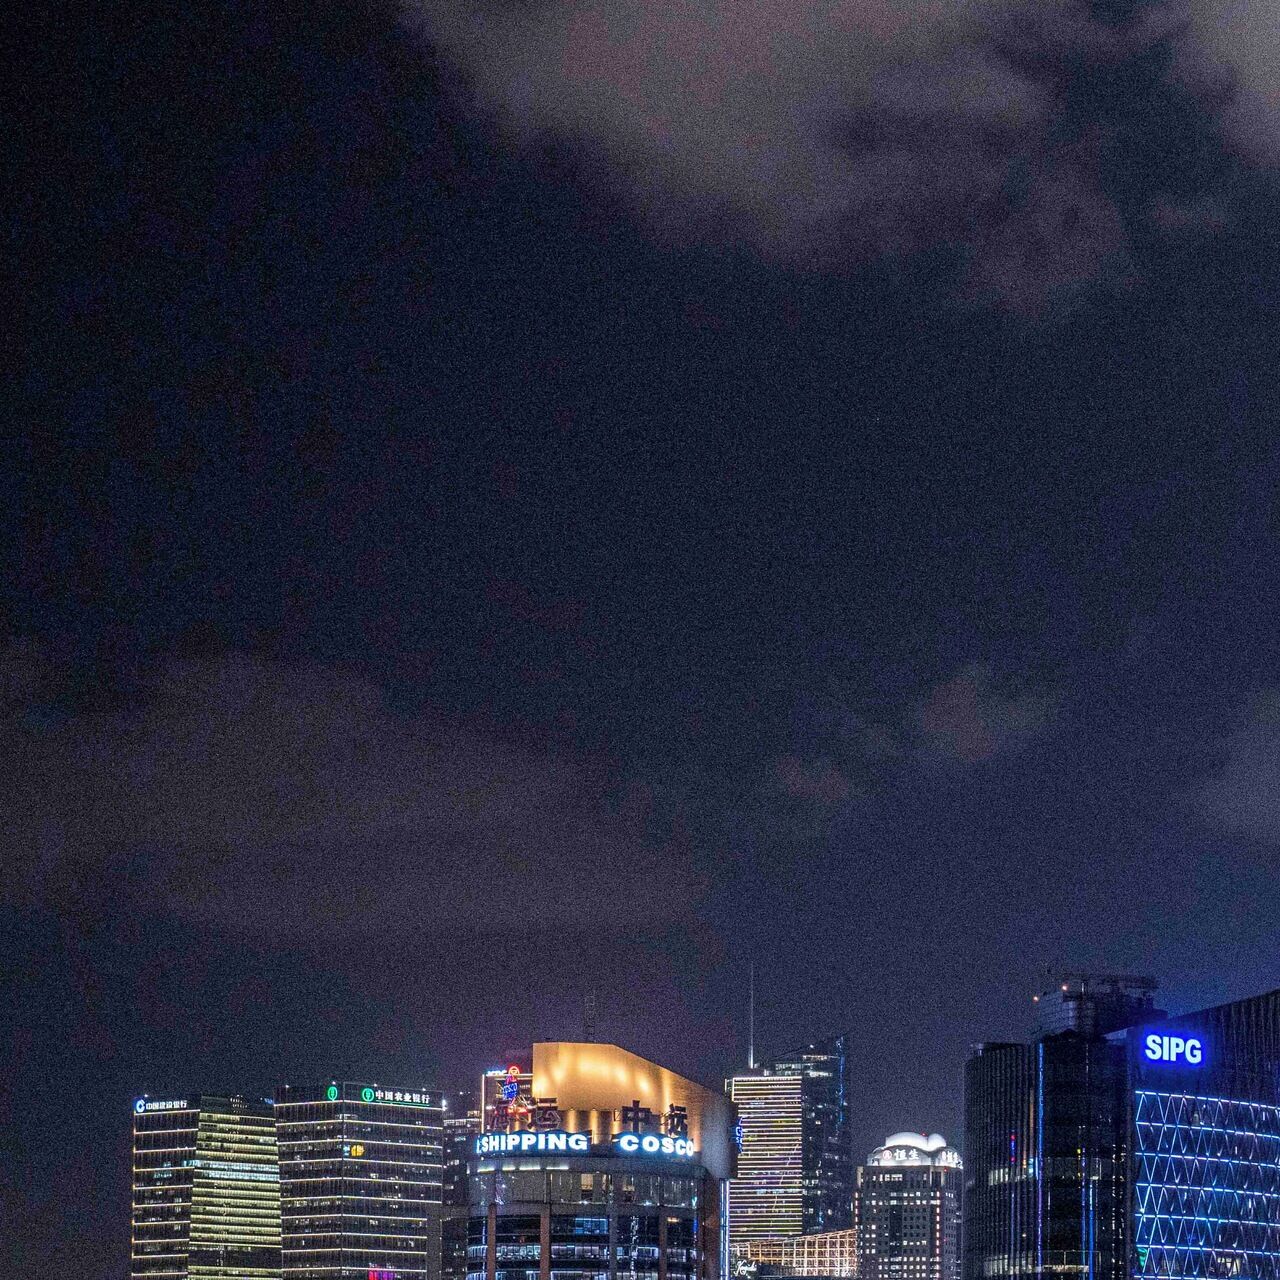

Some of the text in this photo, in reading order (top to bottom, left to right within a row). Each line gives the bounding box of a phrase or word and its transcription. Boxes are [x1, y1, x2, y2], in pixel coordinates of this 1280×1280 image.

[1145, 1034, 1202, 1064] SIPG
[375, 1089, 430, 1104] 中国农业银行
[481, 1133, 588, 1153] SHIPPING
[619, 1134, 694, 1157] COSCO
[894, 1148, 920, 1161] 恒生
